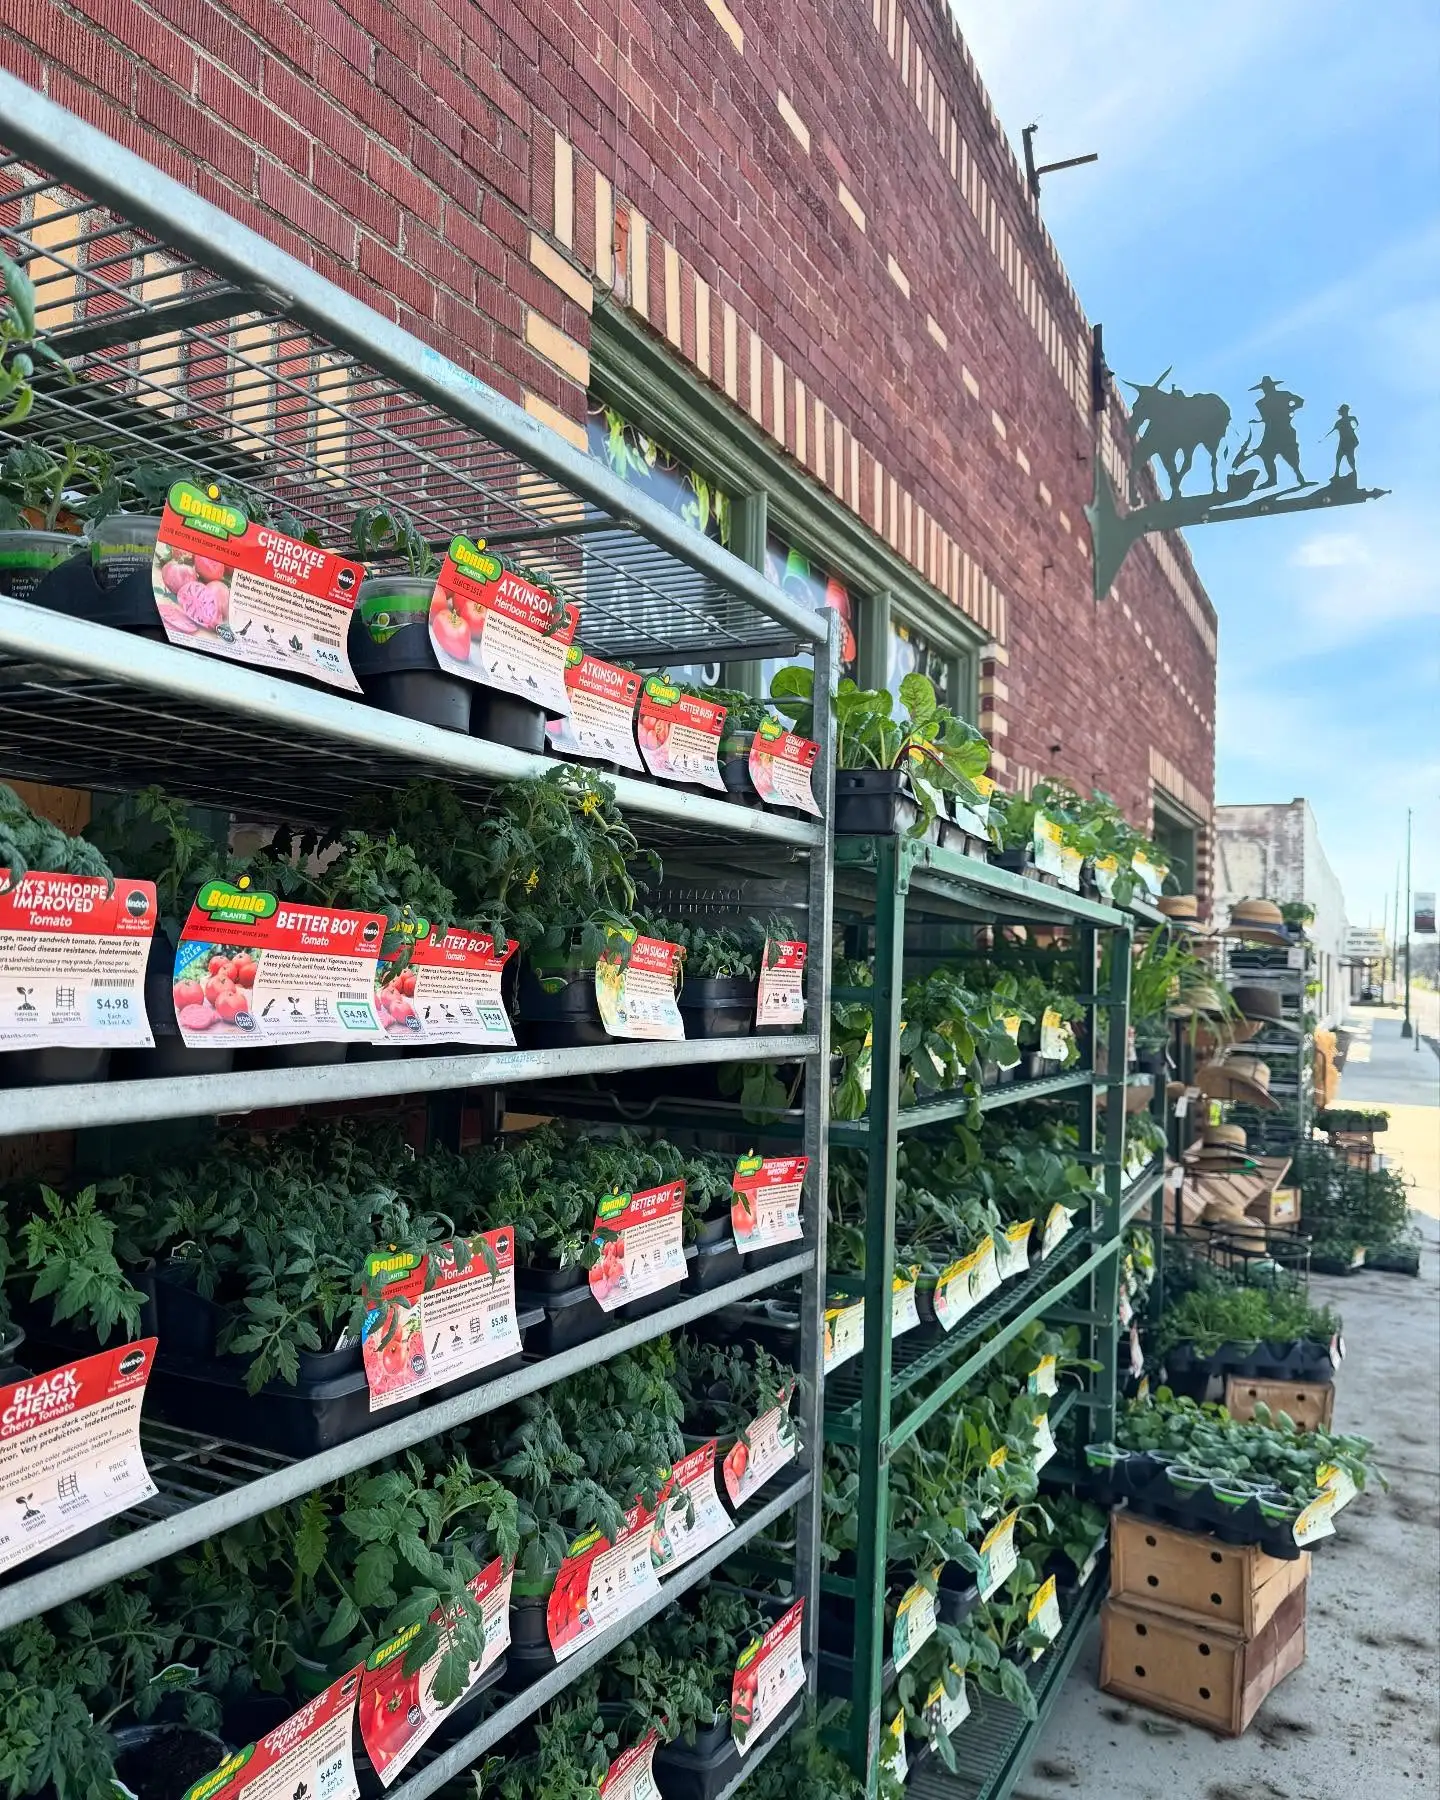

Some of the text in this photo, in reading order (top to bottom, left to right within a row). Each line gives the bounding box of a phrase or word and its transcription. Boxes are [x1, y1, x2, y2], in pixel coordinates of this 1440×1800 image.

[180, 492, 236, 528] Bonnie
[258, 531, 326, 569] CHEROKEE
[455, 544, 495, 576] Bonnie
[265, 551, 312, 580] PURPLE
[273, 568, 297, 585] Tomato
[494, 595, 526, 619] Heirloom
[316, 649, 340, 663] $4.98
[581, 661, 625, 686] ATKINSON
[48, 881, 114, 901] WHOPPE
[207, 889, 266, 912] Bonnie
[13, 893, 94, 913] IMPROVED
[29, 911, 73, 927] Tomato
[220, 911, 248, 920] PLANTS
[276, 911, 359, 936] BETTER BOY
[16, 936, 38, 945] meaty
[39, 936, 70, 944] sandwich
[98, 938, 122, 946] Famous
[122, 939, 132, 947] for
[17, 944, 36, 952] Good
[37, 945, 62, 953] disease
[63, 946, 97, 954] resistance.
[98, 948, 143, 956] Indeterminate.
[181, 943, 194, 957] TOP
[300, 932, 330, 946] Tomato
[467, 938, 495, 954] BOY
[180, 945, 202, 967] SELLER
[445, 950, 466, 961] Tomato
[650, 946, 670, 959] SUGAR
[96, 998, 129, 1010] $4.98
[343, 1009, 368, 1020] $4.98
[631, 1189, 672, 1212] BETTER BOY
[371, 1253, 414, 1277] Bonnie
[491, 1314, 508, 1327] $5.98
[13, 1367, 77, 1405] BLACK
[2, 1382, 83, 1424] CHERRY
[1, 1402, 75, 1437] Cherry Tomato
[19, 1434, 37, 1445] with
[38, 1418, 79, 1438] extra-dark
[80, 1409, 100, 1421] color
[100, 1403, 115, 1415] and
[115, 1397, 131, 1408] tons
[20, 1445, 37, 1458] Very
[39, 1426, 82, 1450] productive.
[84, 1404, 137, 1429] Indeterminate.
[31, 1458, 44, 1468] con
[44, 1452, 61, 1464] color
[108, 1458, 129, 1473] PRICE
[6, 1477, 20, 1488] rico
[20, 1470, 41, 1483] sabor.
[41, 1463, 56, 1475] Muy
[112, 1470, 130, 1483] HERE
[485, 1616, 502, 1636] $4.98
[761, 1611, 794, 1649] ATKINSON
[376, 1622, 421, 1664] Bonnie
[264, 1690, 330, 1749] CHEROKEE
[270, 1711, 316, 1756] PURPLE
[190, 1754, 245, 1800] Bonnie
[320, 1759, 343, 1783] $4.98
